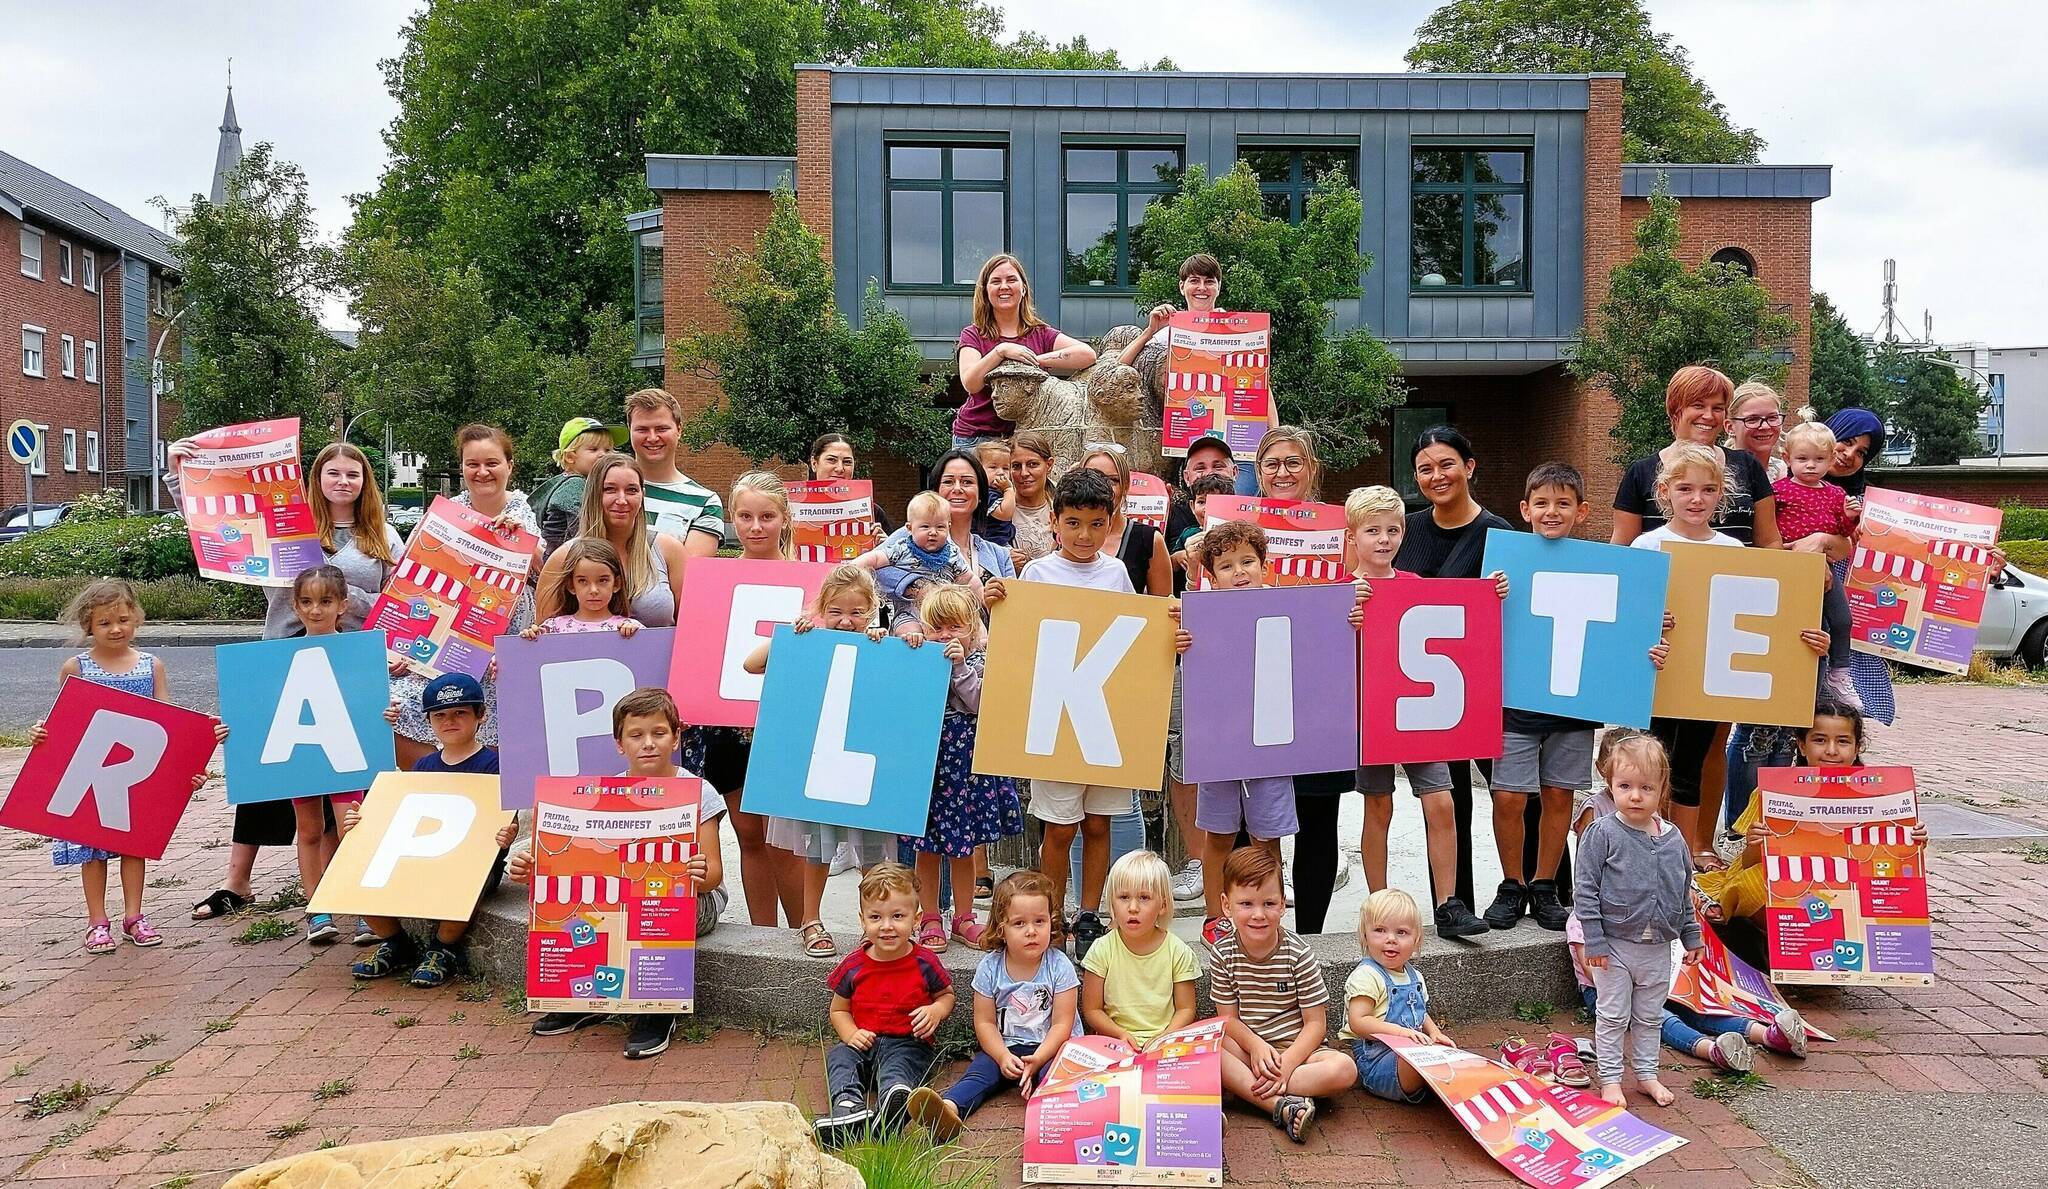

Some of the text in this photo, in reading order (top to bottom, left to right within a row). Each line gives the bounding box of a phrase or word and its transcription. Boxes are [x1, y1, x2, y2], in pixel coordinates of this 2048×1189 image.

[47, 571, 1780, 888] R A P P E L K I S T E
[1798, 775, 1883, 784] RAPPELKISTE
[577, 785, 665, 796] RAPPELKISTE
[1769, 799, 1795, 809] FREITAG,
[681, 812, 690, 820] AB
[1767, 807, 1804, 817] 09.09.2022
[1881, 806, 1912, 816] 15:00 UHR
[544, 811, 571, 823] FREITAG,
[542, 820, 579, 832] 09.09.2022
[659, 820, 692, 831] 15:00 UHR
